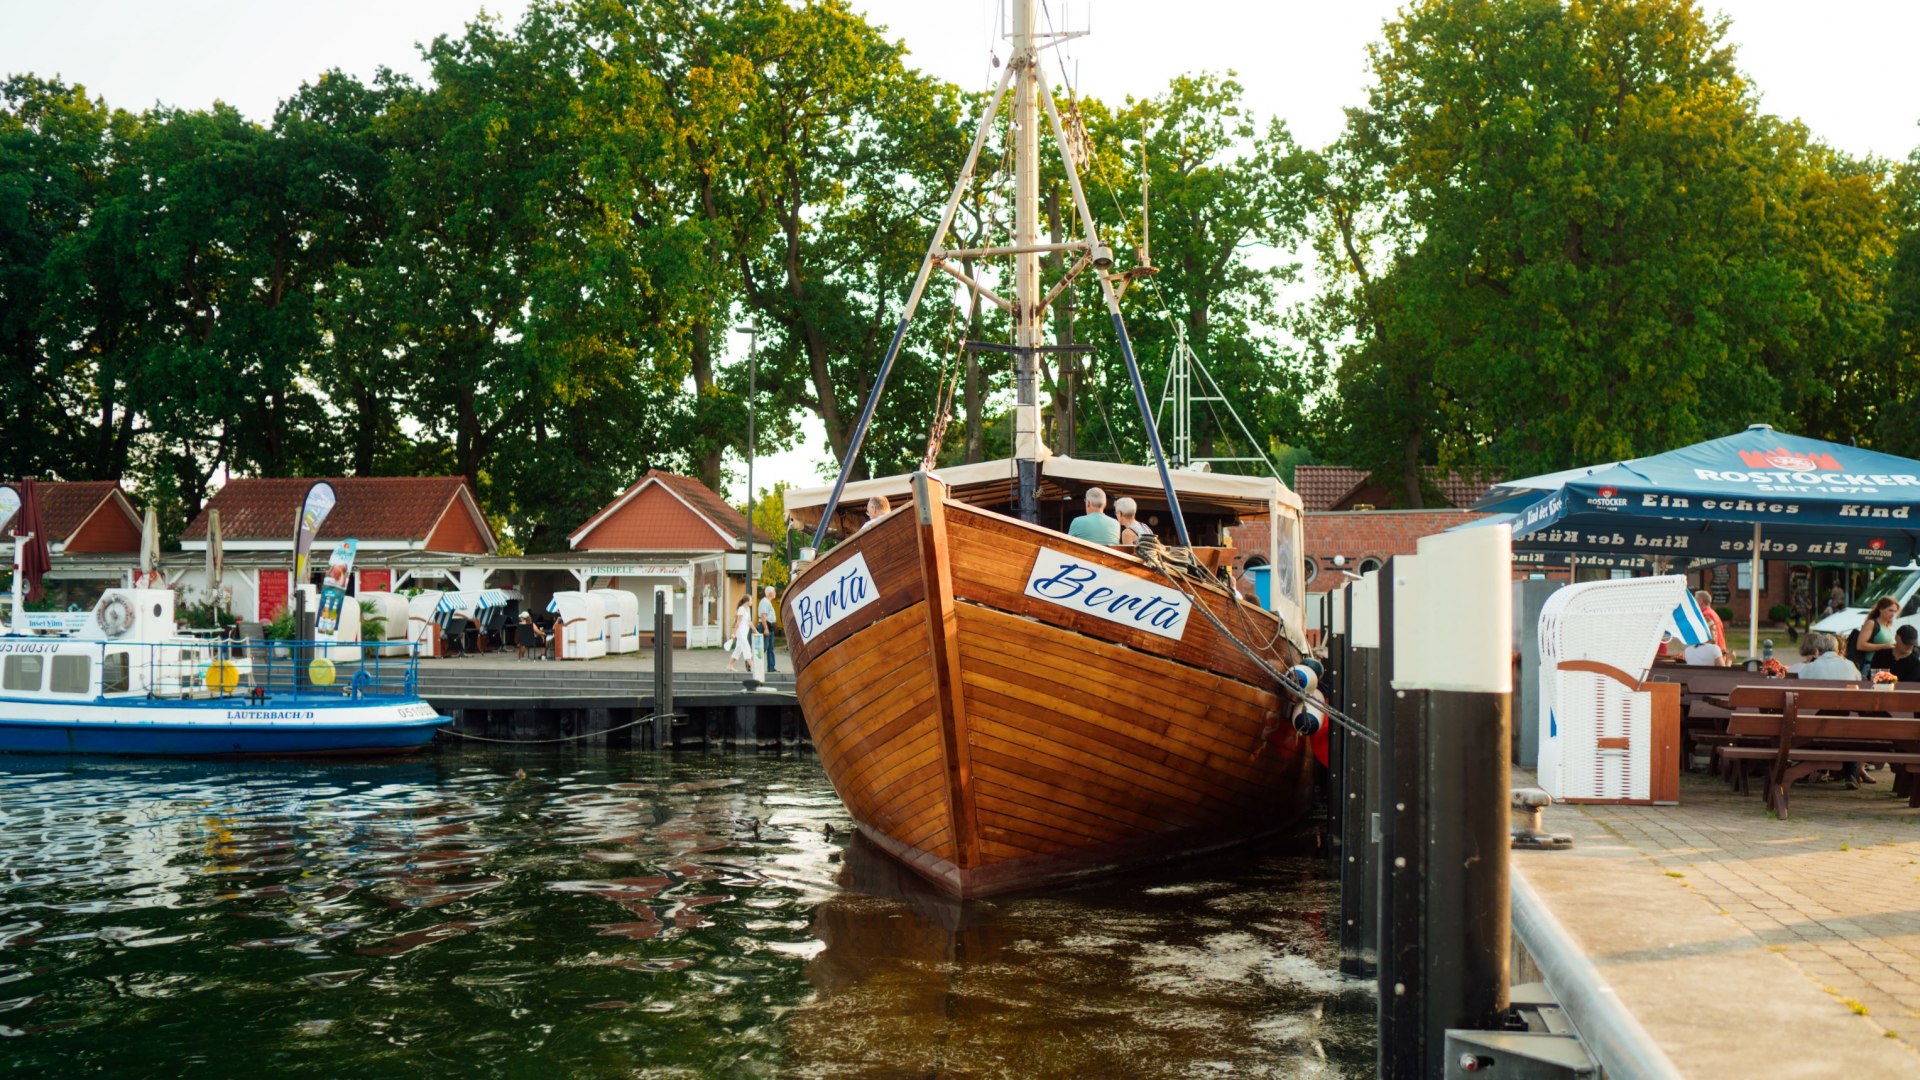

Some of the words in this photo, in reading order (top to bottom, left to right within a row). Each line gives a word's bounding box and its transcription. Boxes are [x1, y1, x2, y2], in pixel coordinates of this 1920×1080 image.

[1694, 469, 1920, 486] ROSTOCKER
[1587, 497, 1628, 506] ROSTOCKER
[1642, 494, 1689, 508] Ein
[1702, 499, 1799, 514] echtes
[1839, 504, 1910, 518] Kind
[799, 567, 868, 638] Berta
[1033, 563, 1182, 630] Berta
[29, 620, 46, 628] Insel
[227, 711, 314, 720] LAUTERBACH/D
